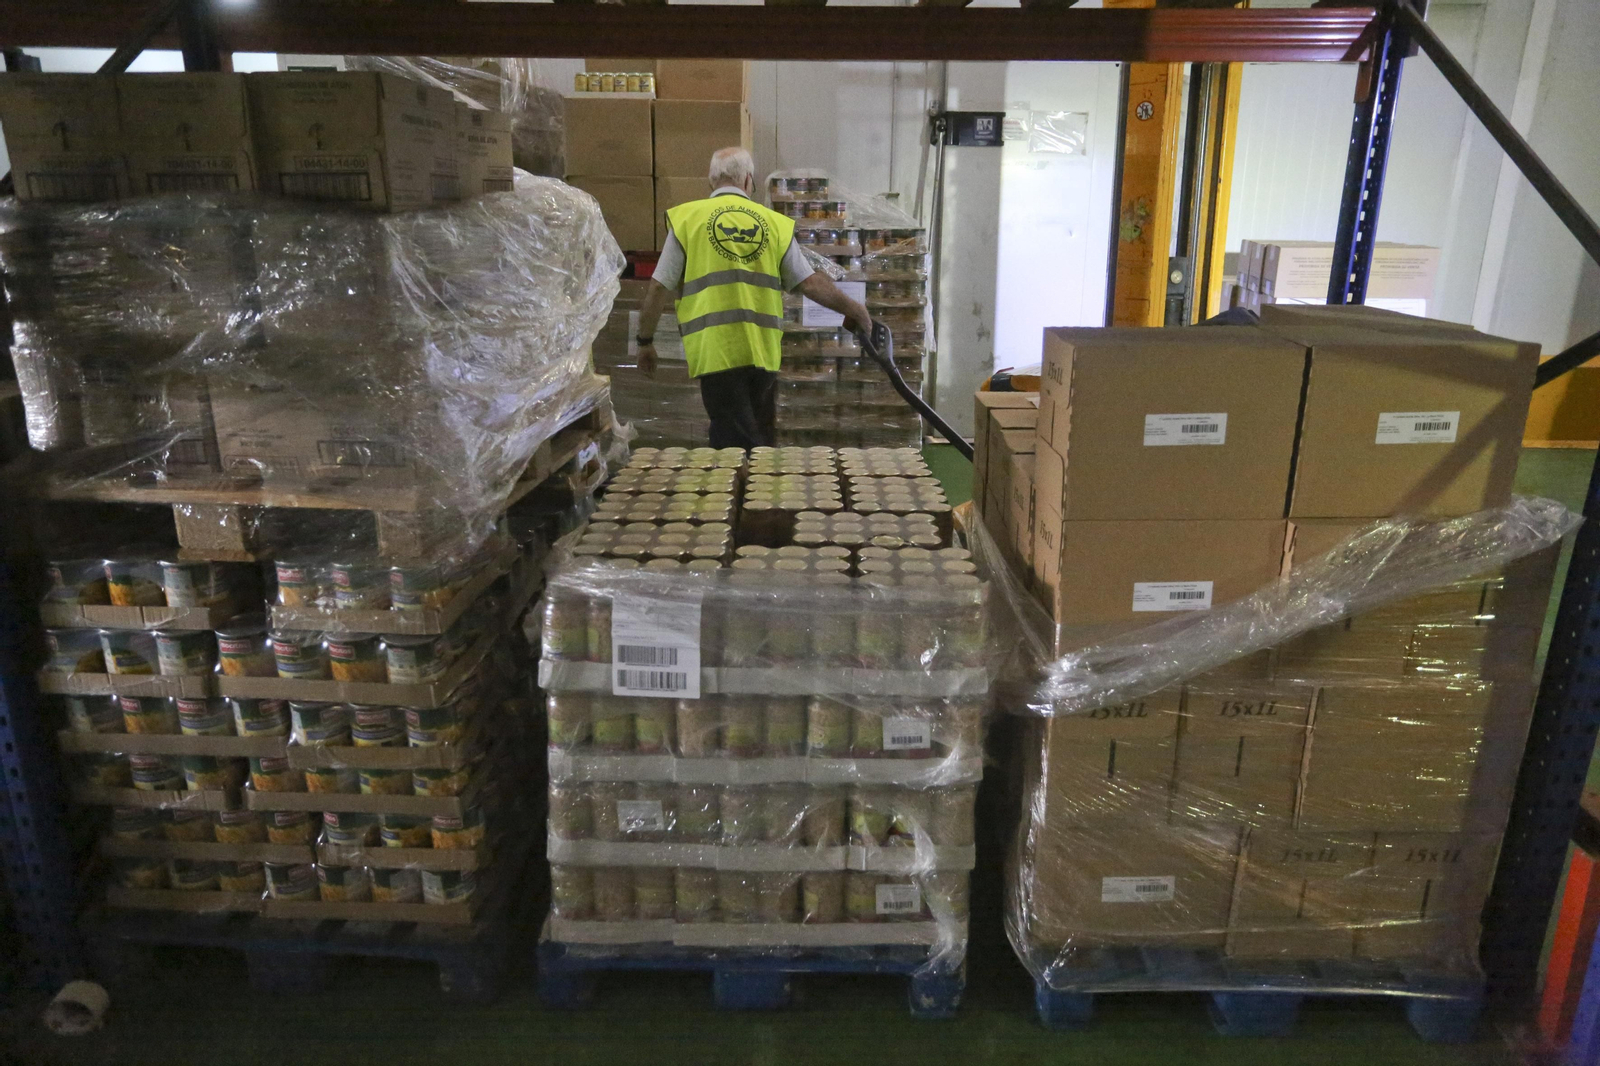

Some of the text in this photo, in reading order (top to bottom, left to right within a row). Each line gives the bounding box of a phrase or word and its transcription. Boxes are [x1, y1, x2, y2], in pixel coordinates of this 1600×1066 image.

[707, 206, 724, 231] BANCOS
[738, 205, 770, 232] ALIMENTOS
[708, 234, 734, 262] BANCOS
[1219, 701, 1278, 718] 15x1L
